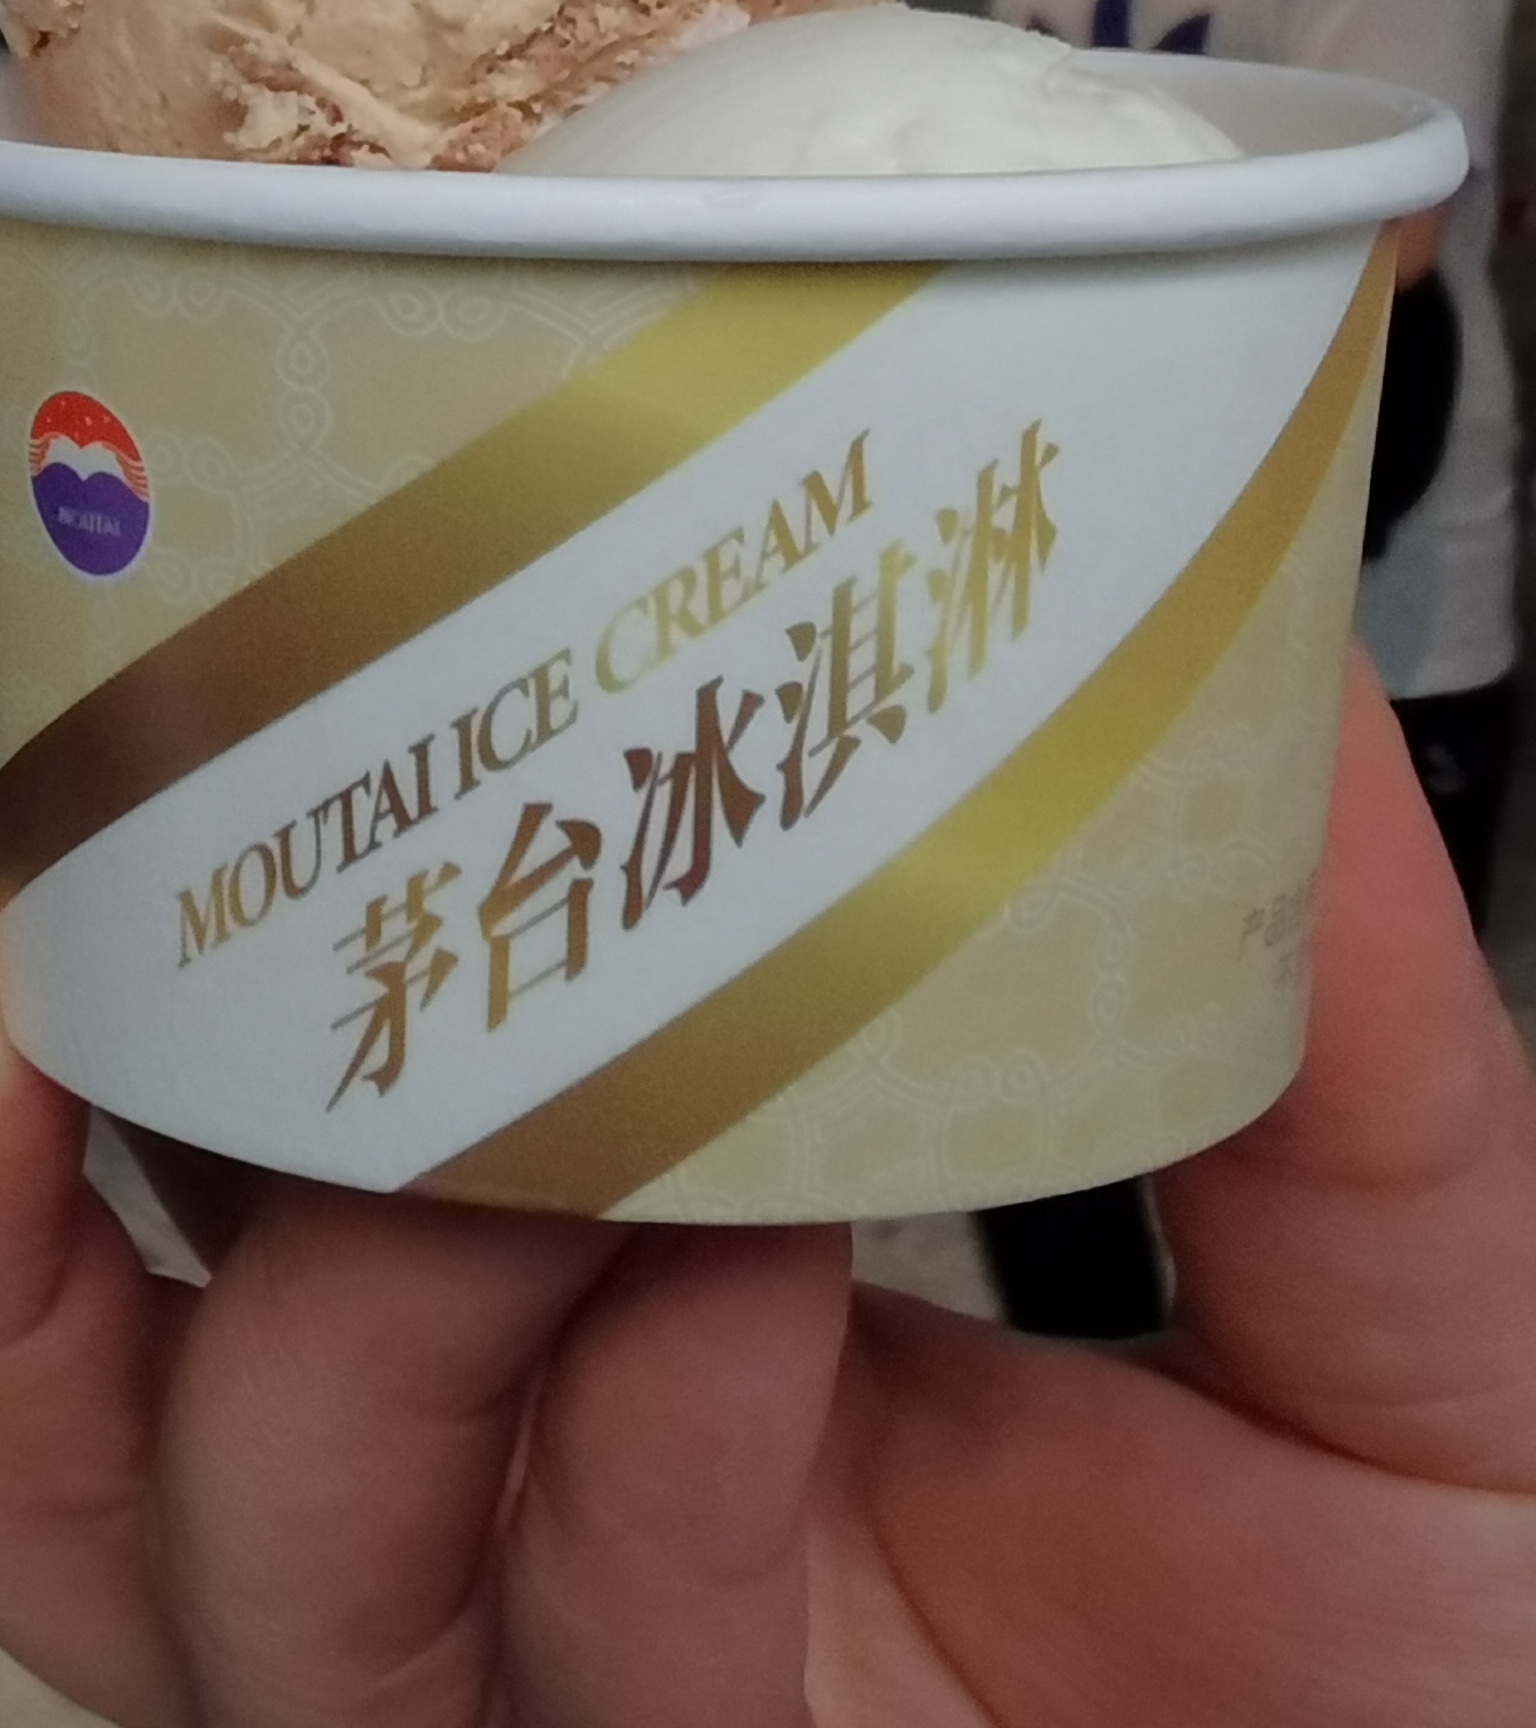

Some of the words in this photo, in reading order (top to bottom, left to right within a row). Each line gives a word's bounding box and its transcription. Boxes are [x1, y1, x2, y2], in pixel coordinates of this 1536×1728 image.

[177, 733, 438, 969] MOUTAI
[451, 648, 579, 800] ICE
[593, 428, 872, 695] CREAM
[325, 419, 1060, 1112] 茅台冰淇淋
